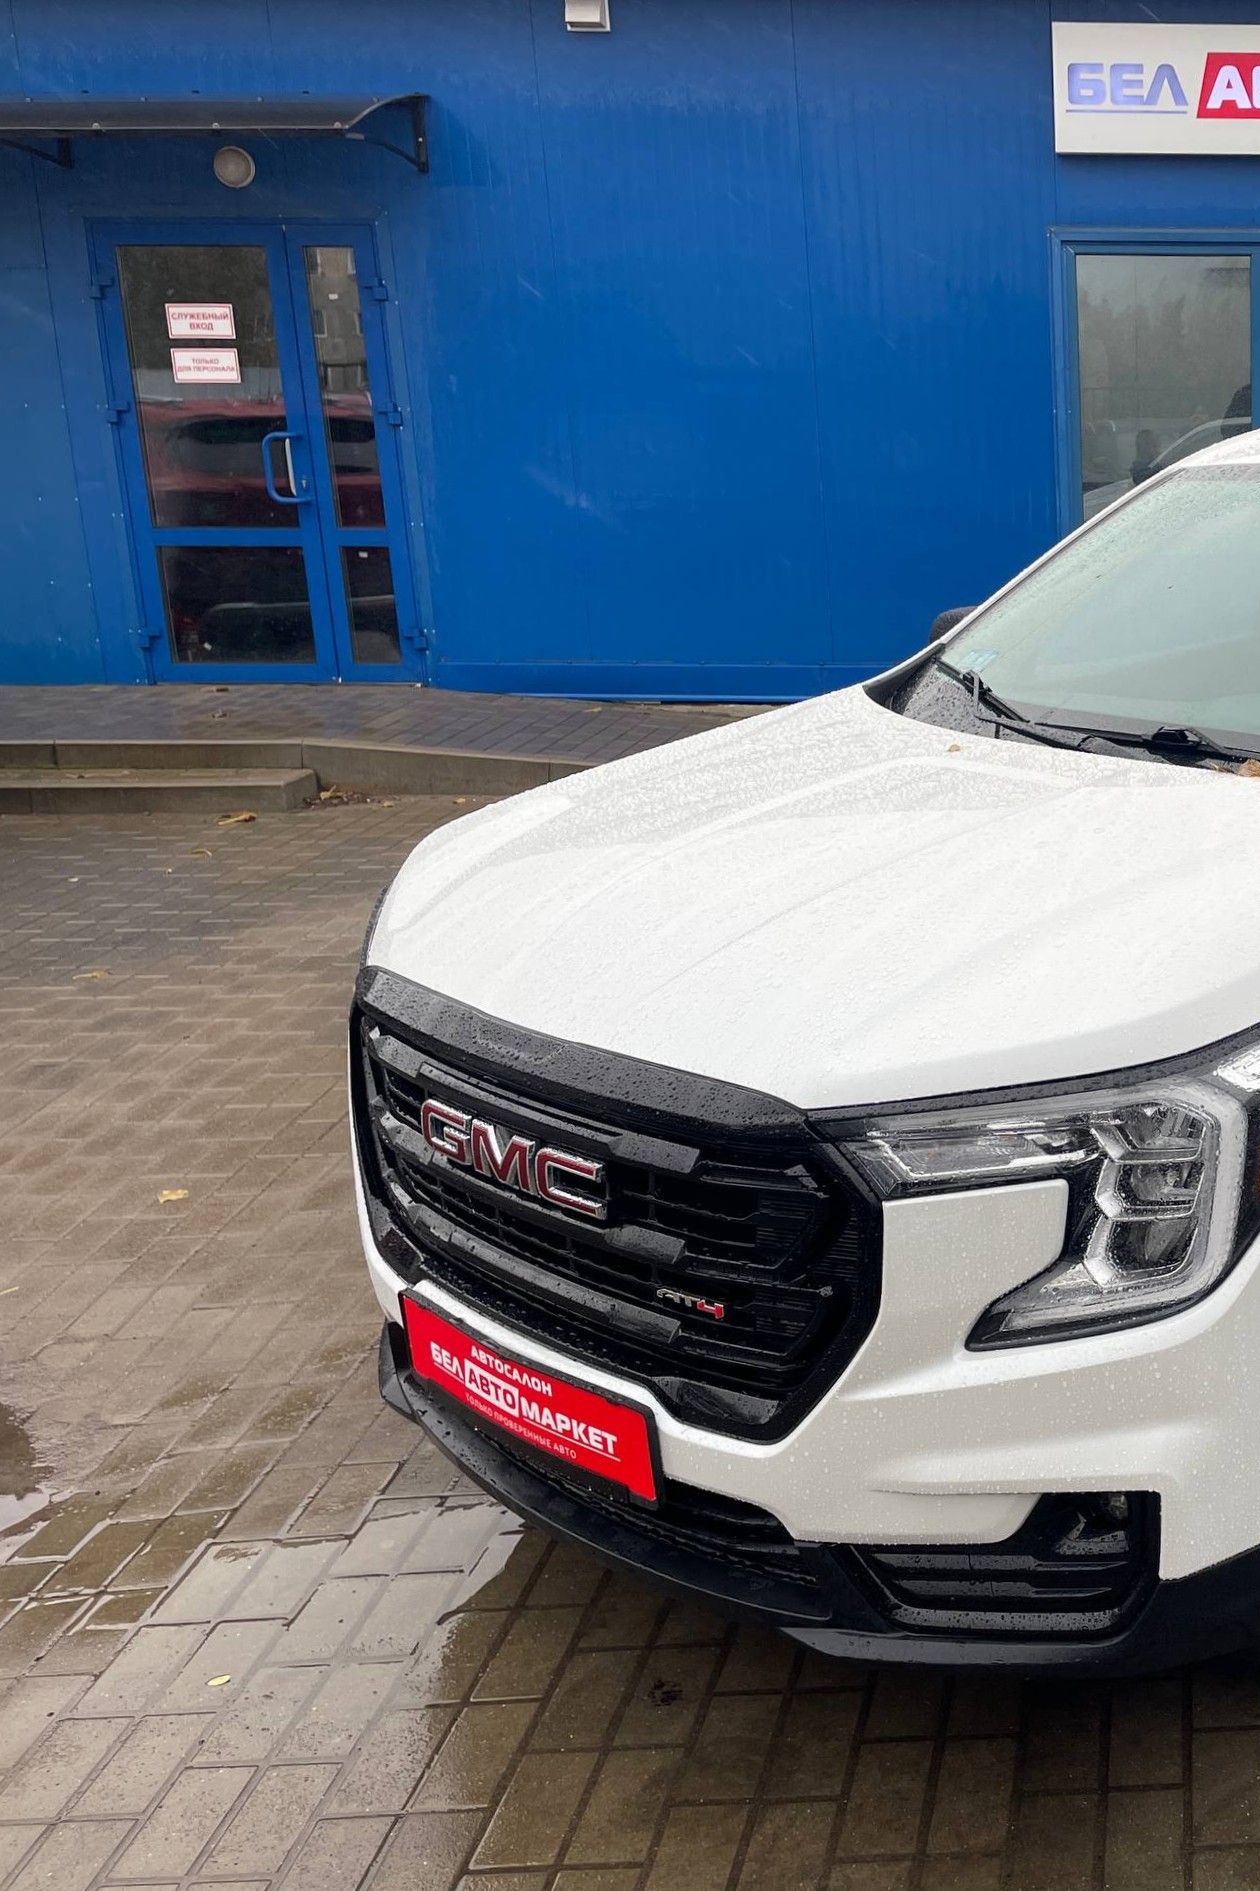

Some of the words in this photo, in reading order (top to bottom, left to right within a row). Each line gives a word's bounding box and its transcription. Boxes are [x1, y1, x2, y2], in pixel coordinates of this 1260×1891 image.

[1066, 63, 1188, 107] БЕЛ
[171, 311, 229, 321] СЛУЖЕБНЫЙ
[189, 322, 214, 331] ВХОД
[420, 1098, 609, 1221] GMC
[471, 1345, 553, 1397] АВТОСАЛОН
[430, 1341, 464, 1382] БЕЛ
[468, 1367, 517, 1411] АВТО
[520, 1396, 618, 1455] МАРКЕТ
[465, 1392, 493, 1417] ТОЛЬКО
[493, 1410, 552, 1448] ПРОВЕРЕННЫЕ
[553, 1442, 577, 1459] АВТО
